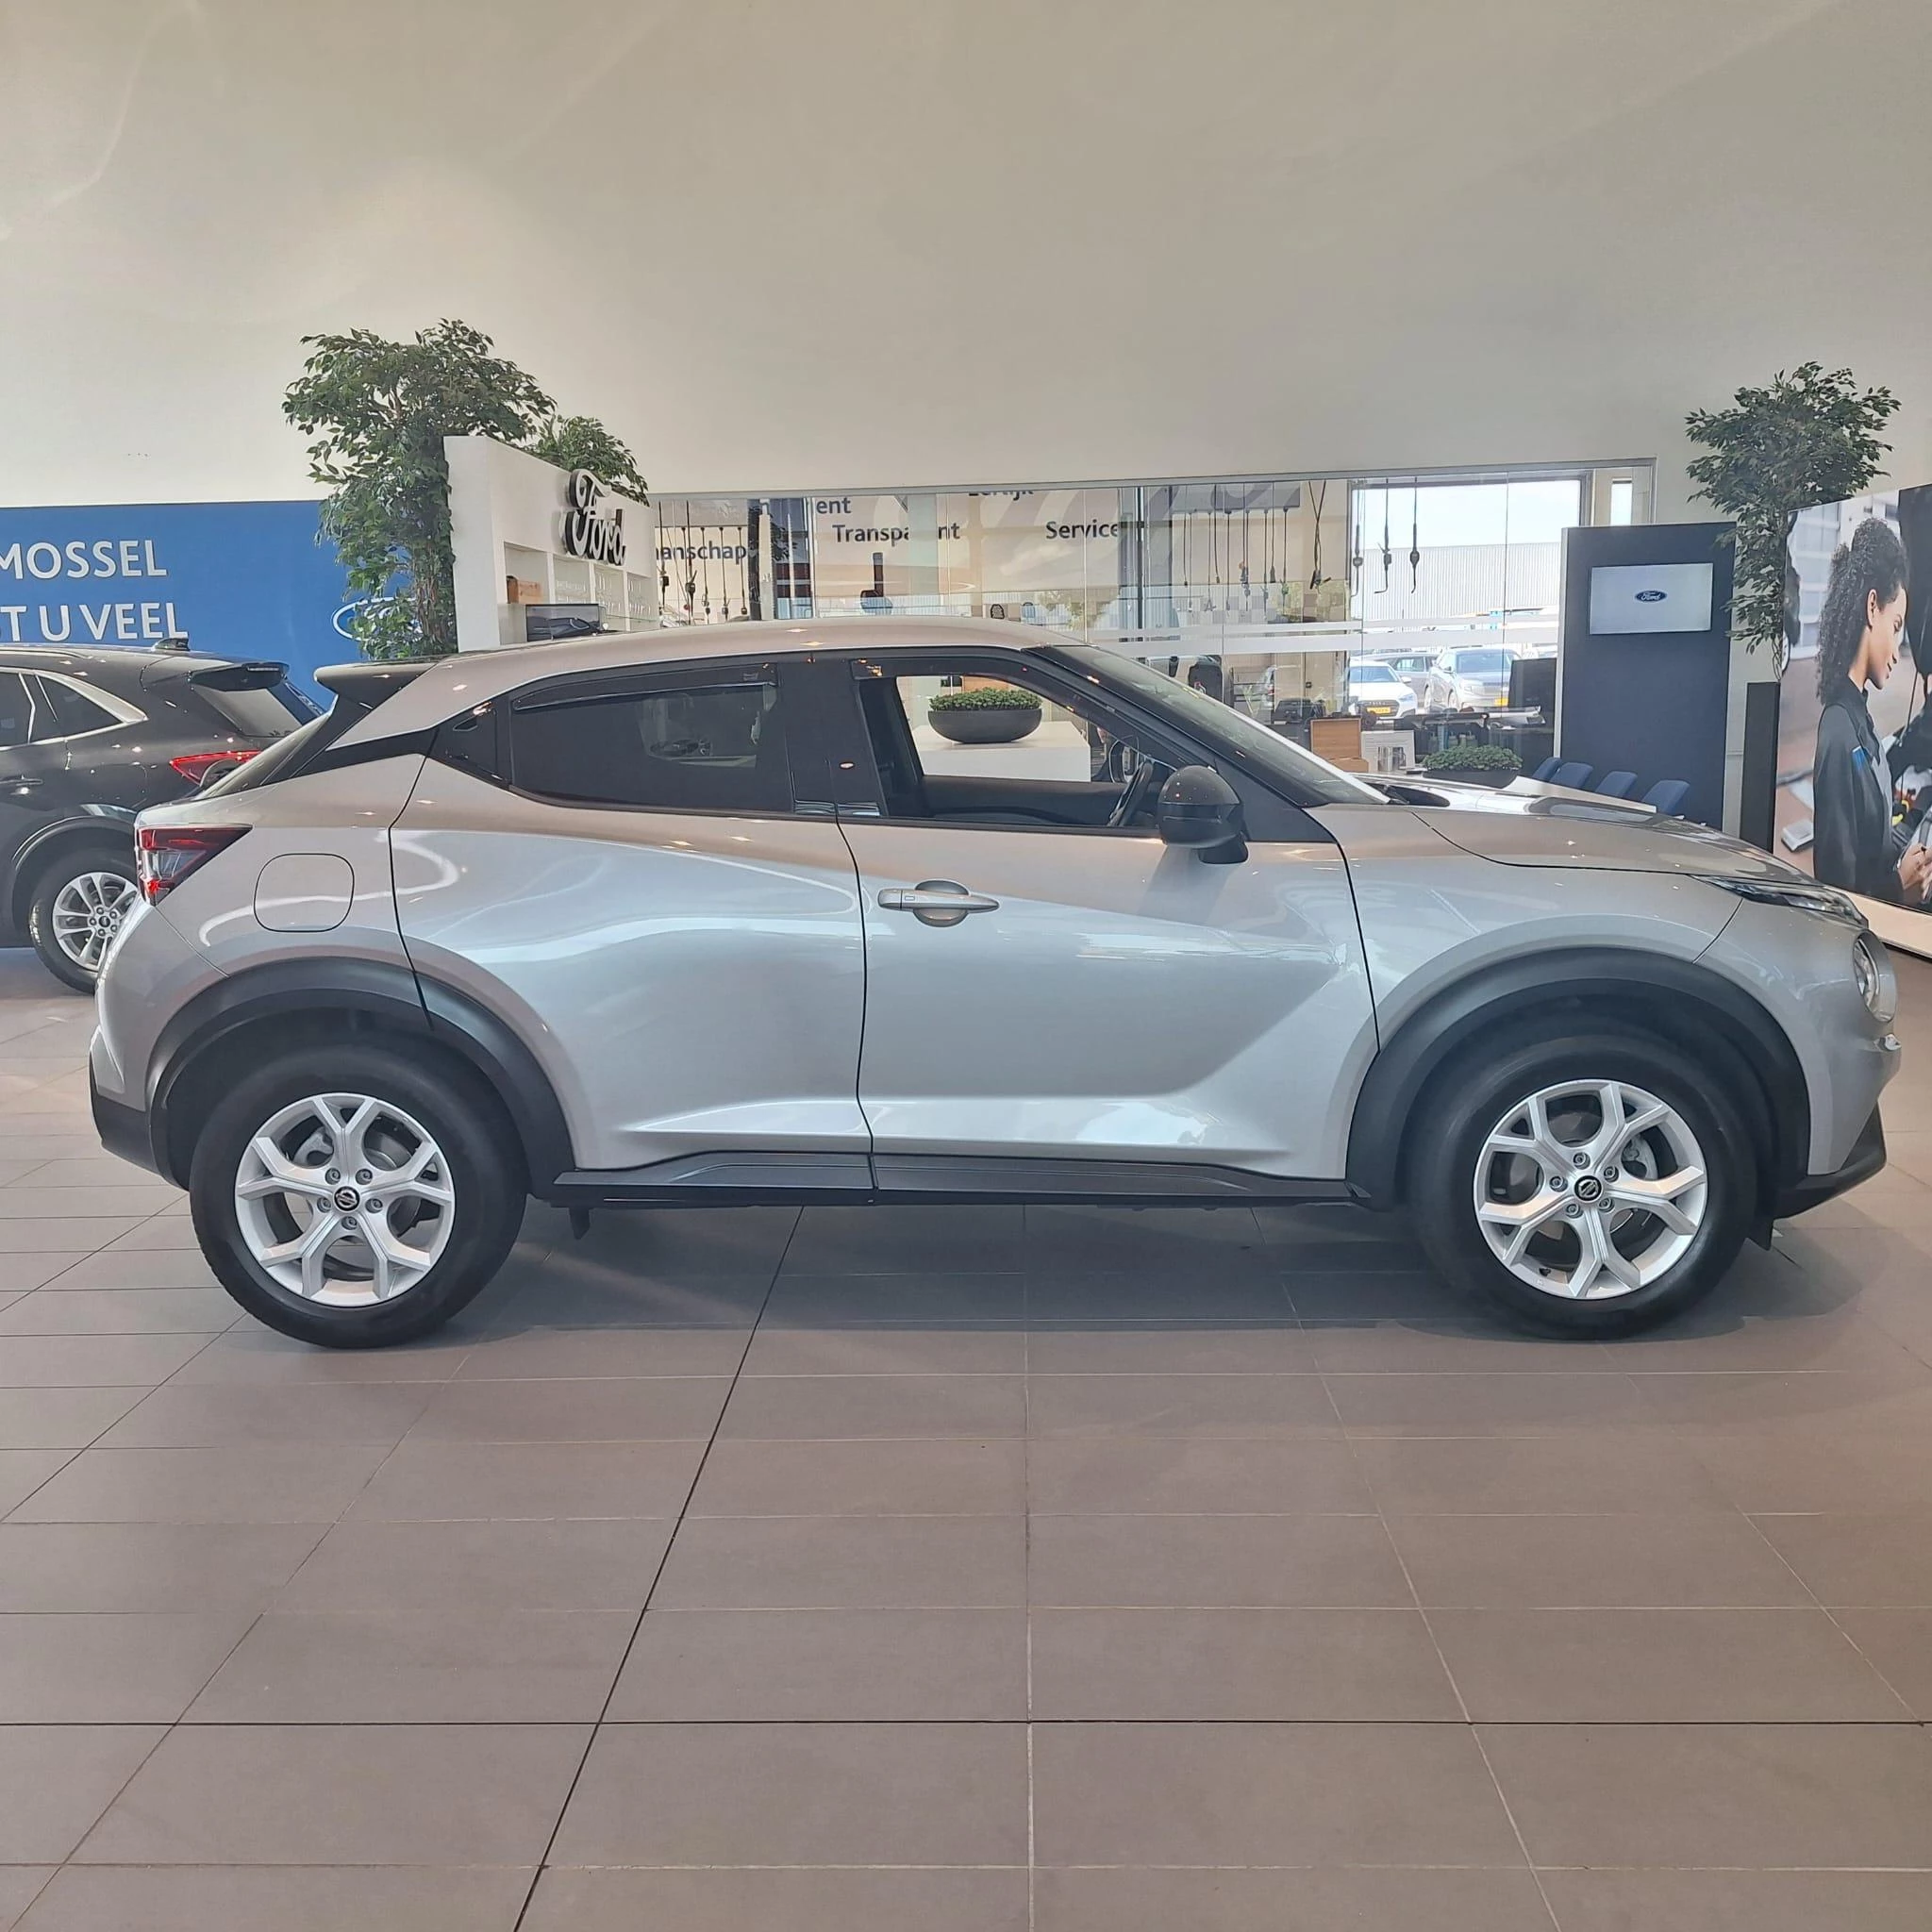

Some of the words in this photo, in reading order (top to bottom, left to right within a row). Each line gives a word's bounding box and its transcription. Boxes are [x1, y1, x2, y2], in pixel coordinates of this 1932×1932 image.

[566, 468, 626, 566] Ford
[832, 523, 960, 546] Transpant
[1045, 519, 1117, 539] Service
[0, 540, 167, 579] MOSSEL
[39, 605, 71, 641] U
[79, 602, 189, 641] VEEL
